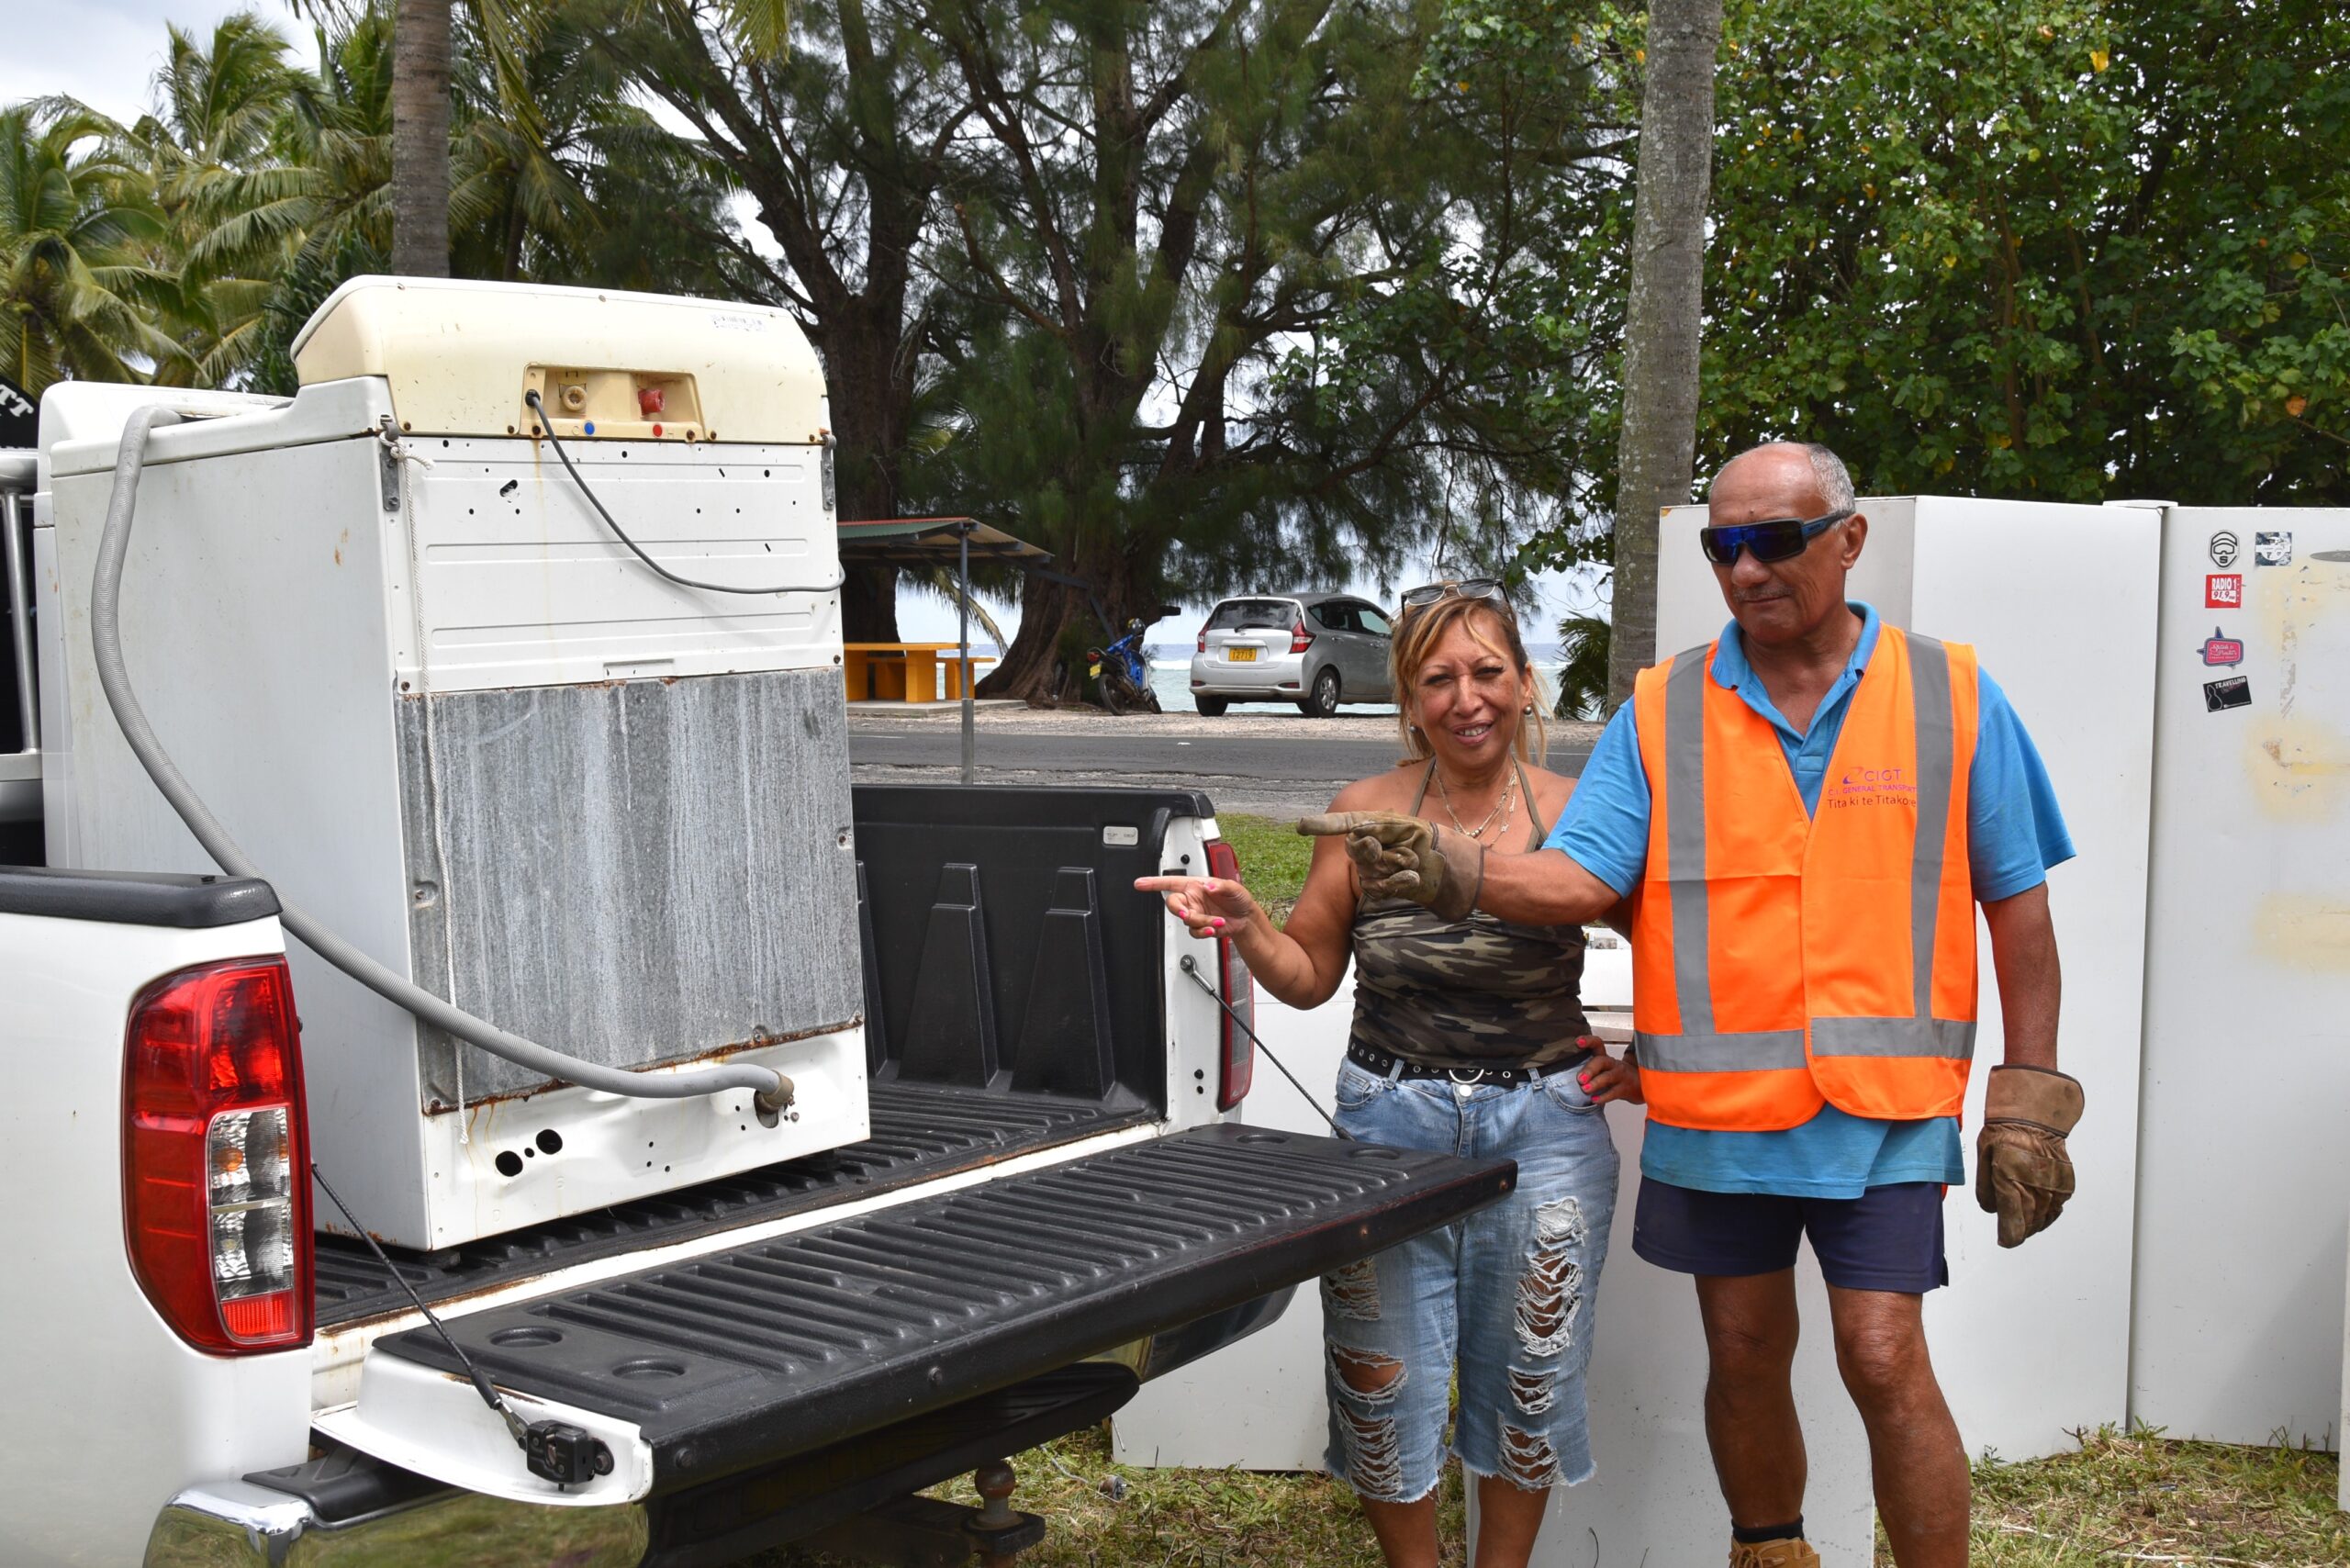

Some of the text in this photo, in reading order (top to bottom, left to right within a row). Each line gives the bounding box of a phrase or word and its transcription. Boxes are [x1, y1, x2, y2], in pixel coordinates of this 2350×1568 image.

[2211, 577, 2232, 590] RADIO
[2233, 577, 2237, 590] 1
[1842, 785, 1874, 794] GENERAL
[1827, 799, 1847, 809] Tita
[1850, 796, 1859, 806] ki
[1863, 797, 1873, 805] te
